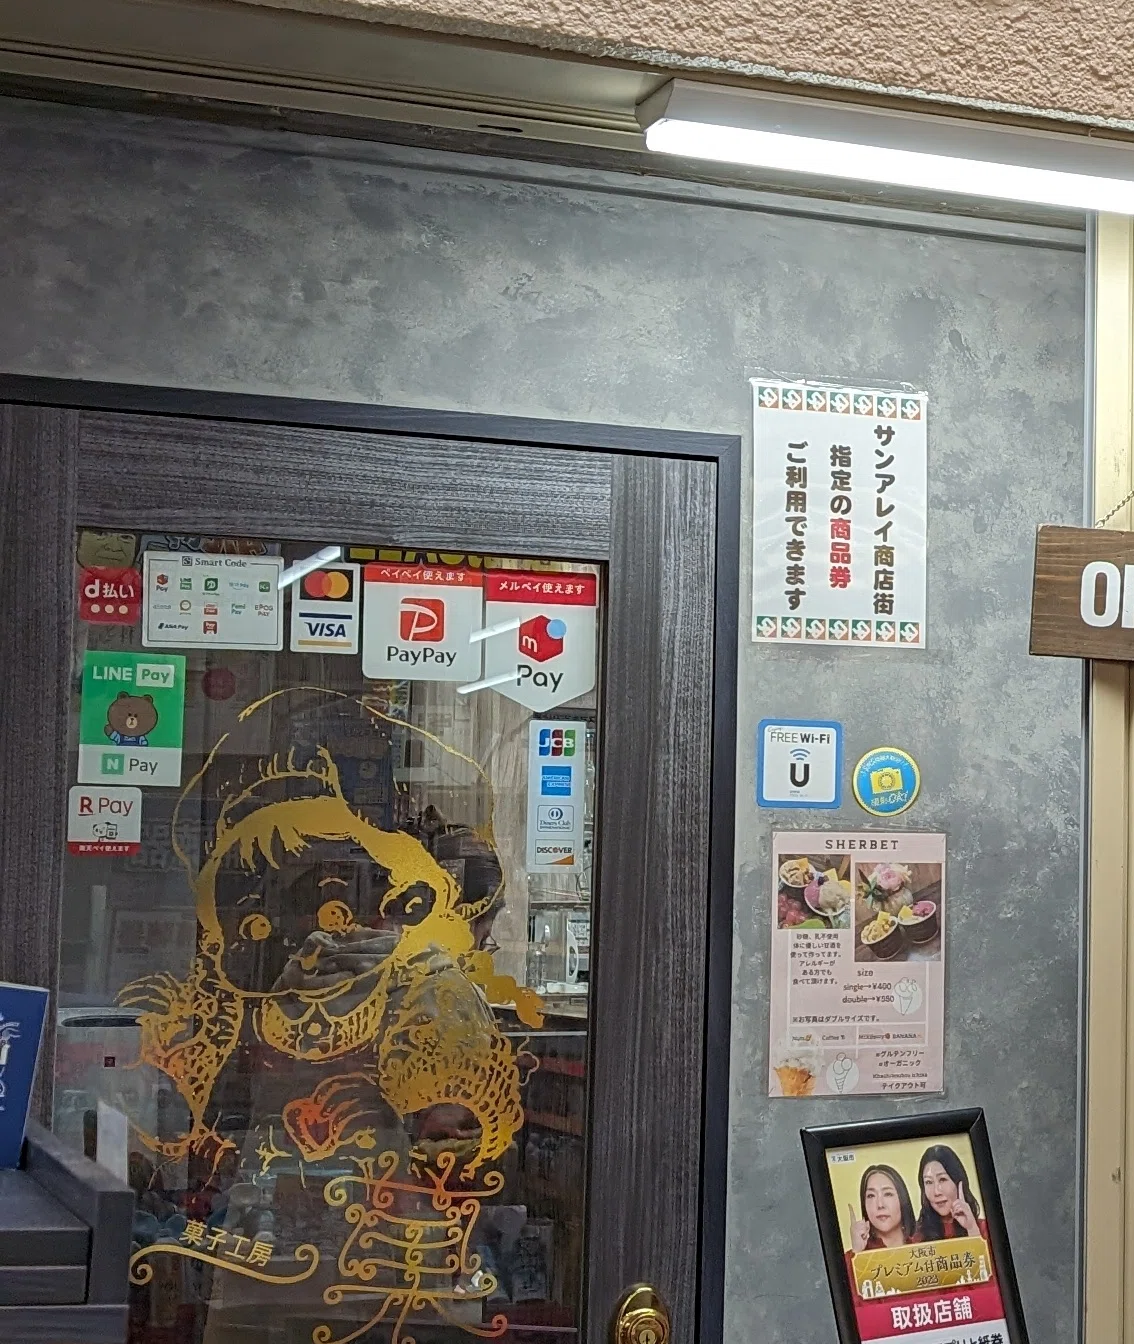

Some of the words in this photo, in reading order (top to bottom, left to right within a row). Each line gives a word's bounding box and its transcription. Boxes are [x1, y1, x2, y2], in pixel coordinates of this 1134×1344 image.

[784, 440, 808, 611] ご利用できます
[829, 445, 852, 589] 指定の商品券
[873, 425, 895, 615] サンアレイ商店街
[195, 558, 222, 567] Smart
[224, 559, 247, 567] Code
[381, 569, 465, 581] ペイペイ使えます
[84, 579, 135, 599] d払い
[499, 581, 585, 595] メルペイ使えます
[304, 622, 346, 637] VISA
[387, 645, 457, 667] PayPay
[93, 666, 132, 681] LINE
[142, 668, 171, 685] Pay
[516, 665, 564, 693] Pay
[770, 732, 798, 744] FREE
[800, 733, 831, 744] Wi-Fi
[128, 758, 158, 775] Pay
[78, 797, 94, 816] R
[98, 797, 133, 816] Pay
[536, 846, 573, 854] DISCOVER
[825, 839, 899, 850] SHERBET
[857, 968, 874, 977] size
[179, 1219, 273, 1267] 菓子工房
[909, 1245, 936, 1260] 大阪市
[871, 1251, 976, 1280] プレミアム付商品券
[891, 1296, 972, 1330] 取扱店舗
